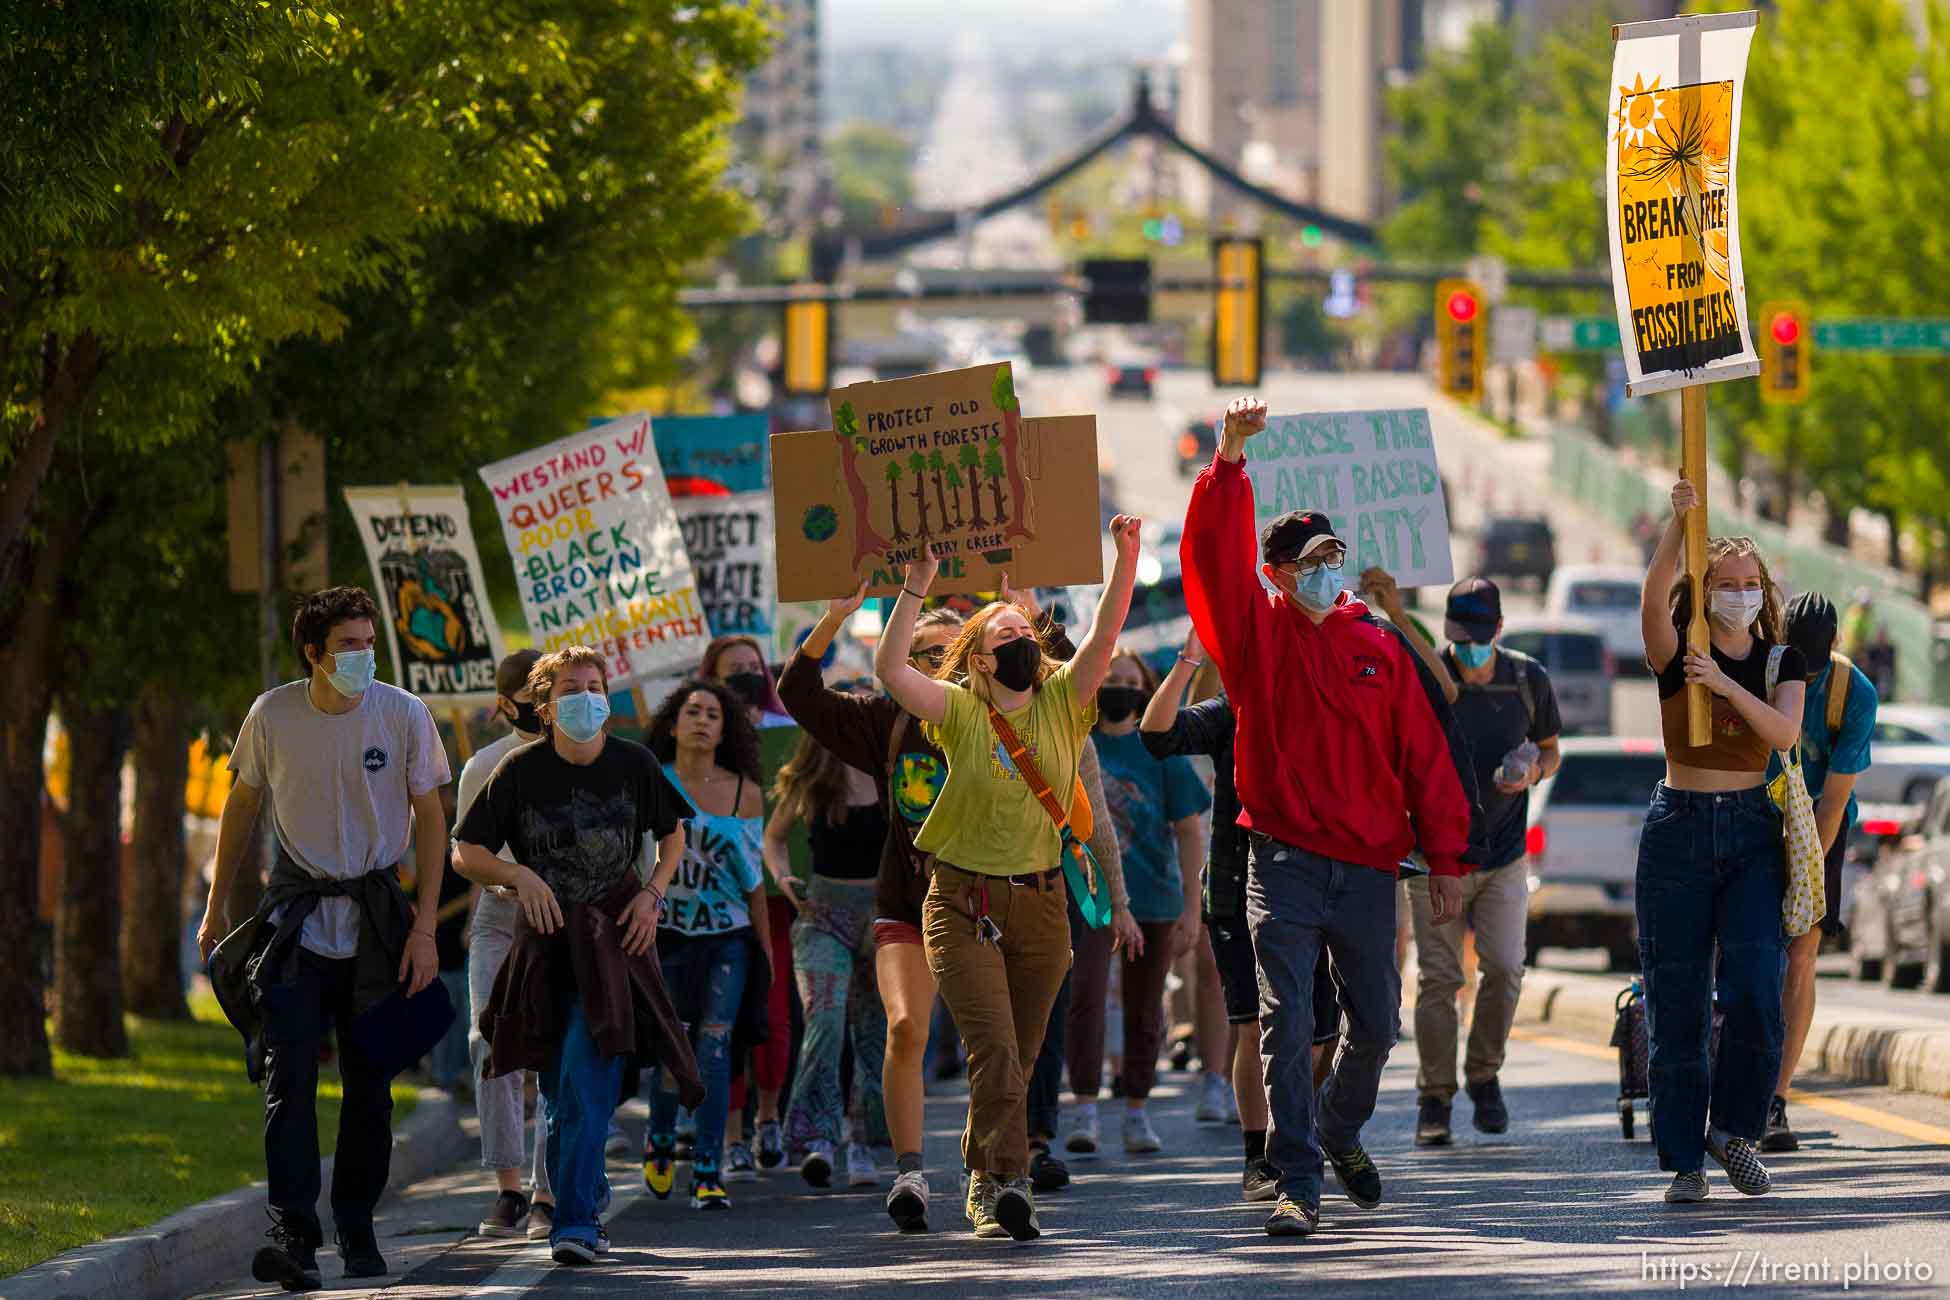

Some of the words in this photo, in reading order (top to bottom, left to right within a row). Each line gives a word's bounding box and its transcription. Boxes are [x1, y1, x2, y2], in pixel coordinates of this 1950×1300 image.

[1623, 196, 1688, 244] BREAK
[1700, 189, 1725, 232] FREE
[1666, 261, 1705, 290] FROM
[1633, 300, 1693, 350] FOSSIL
[1694, 290, 1737, 342] FUELS
[615, 419, 648, 456] W/
[867, 406, 934, 433] PROTECT
[949, 400, 979, 416] OLD
[1366, 409, 1431, 449] THE
[870, 433, 927, 456] GROWTH
[933, 422, 1000, 447] FORESTS
[512, 459, 644, 528] QUEERS
[1251, 463, 1341, 516] LANT
[1352, 458, 1438, 505] BASED
[519, 508, 597, 553] POOR
[527, 520, 633, 581] BLACK
[680, 512, 760, 549] OTECT
[886, 547, 918, 565] SAVE
[966, 534, 1003, 550] CREEK
[533, 547, 642, 603] BROWN
[539, 571, 666, 631] NATIVE
[408, 659, 497, 691] FUTURE
